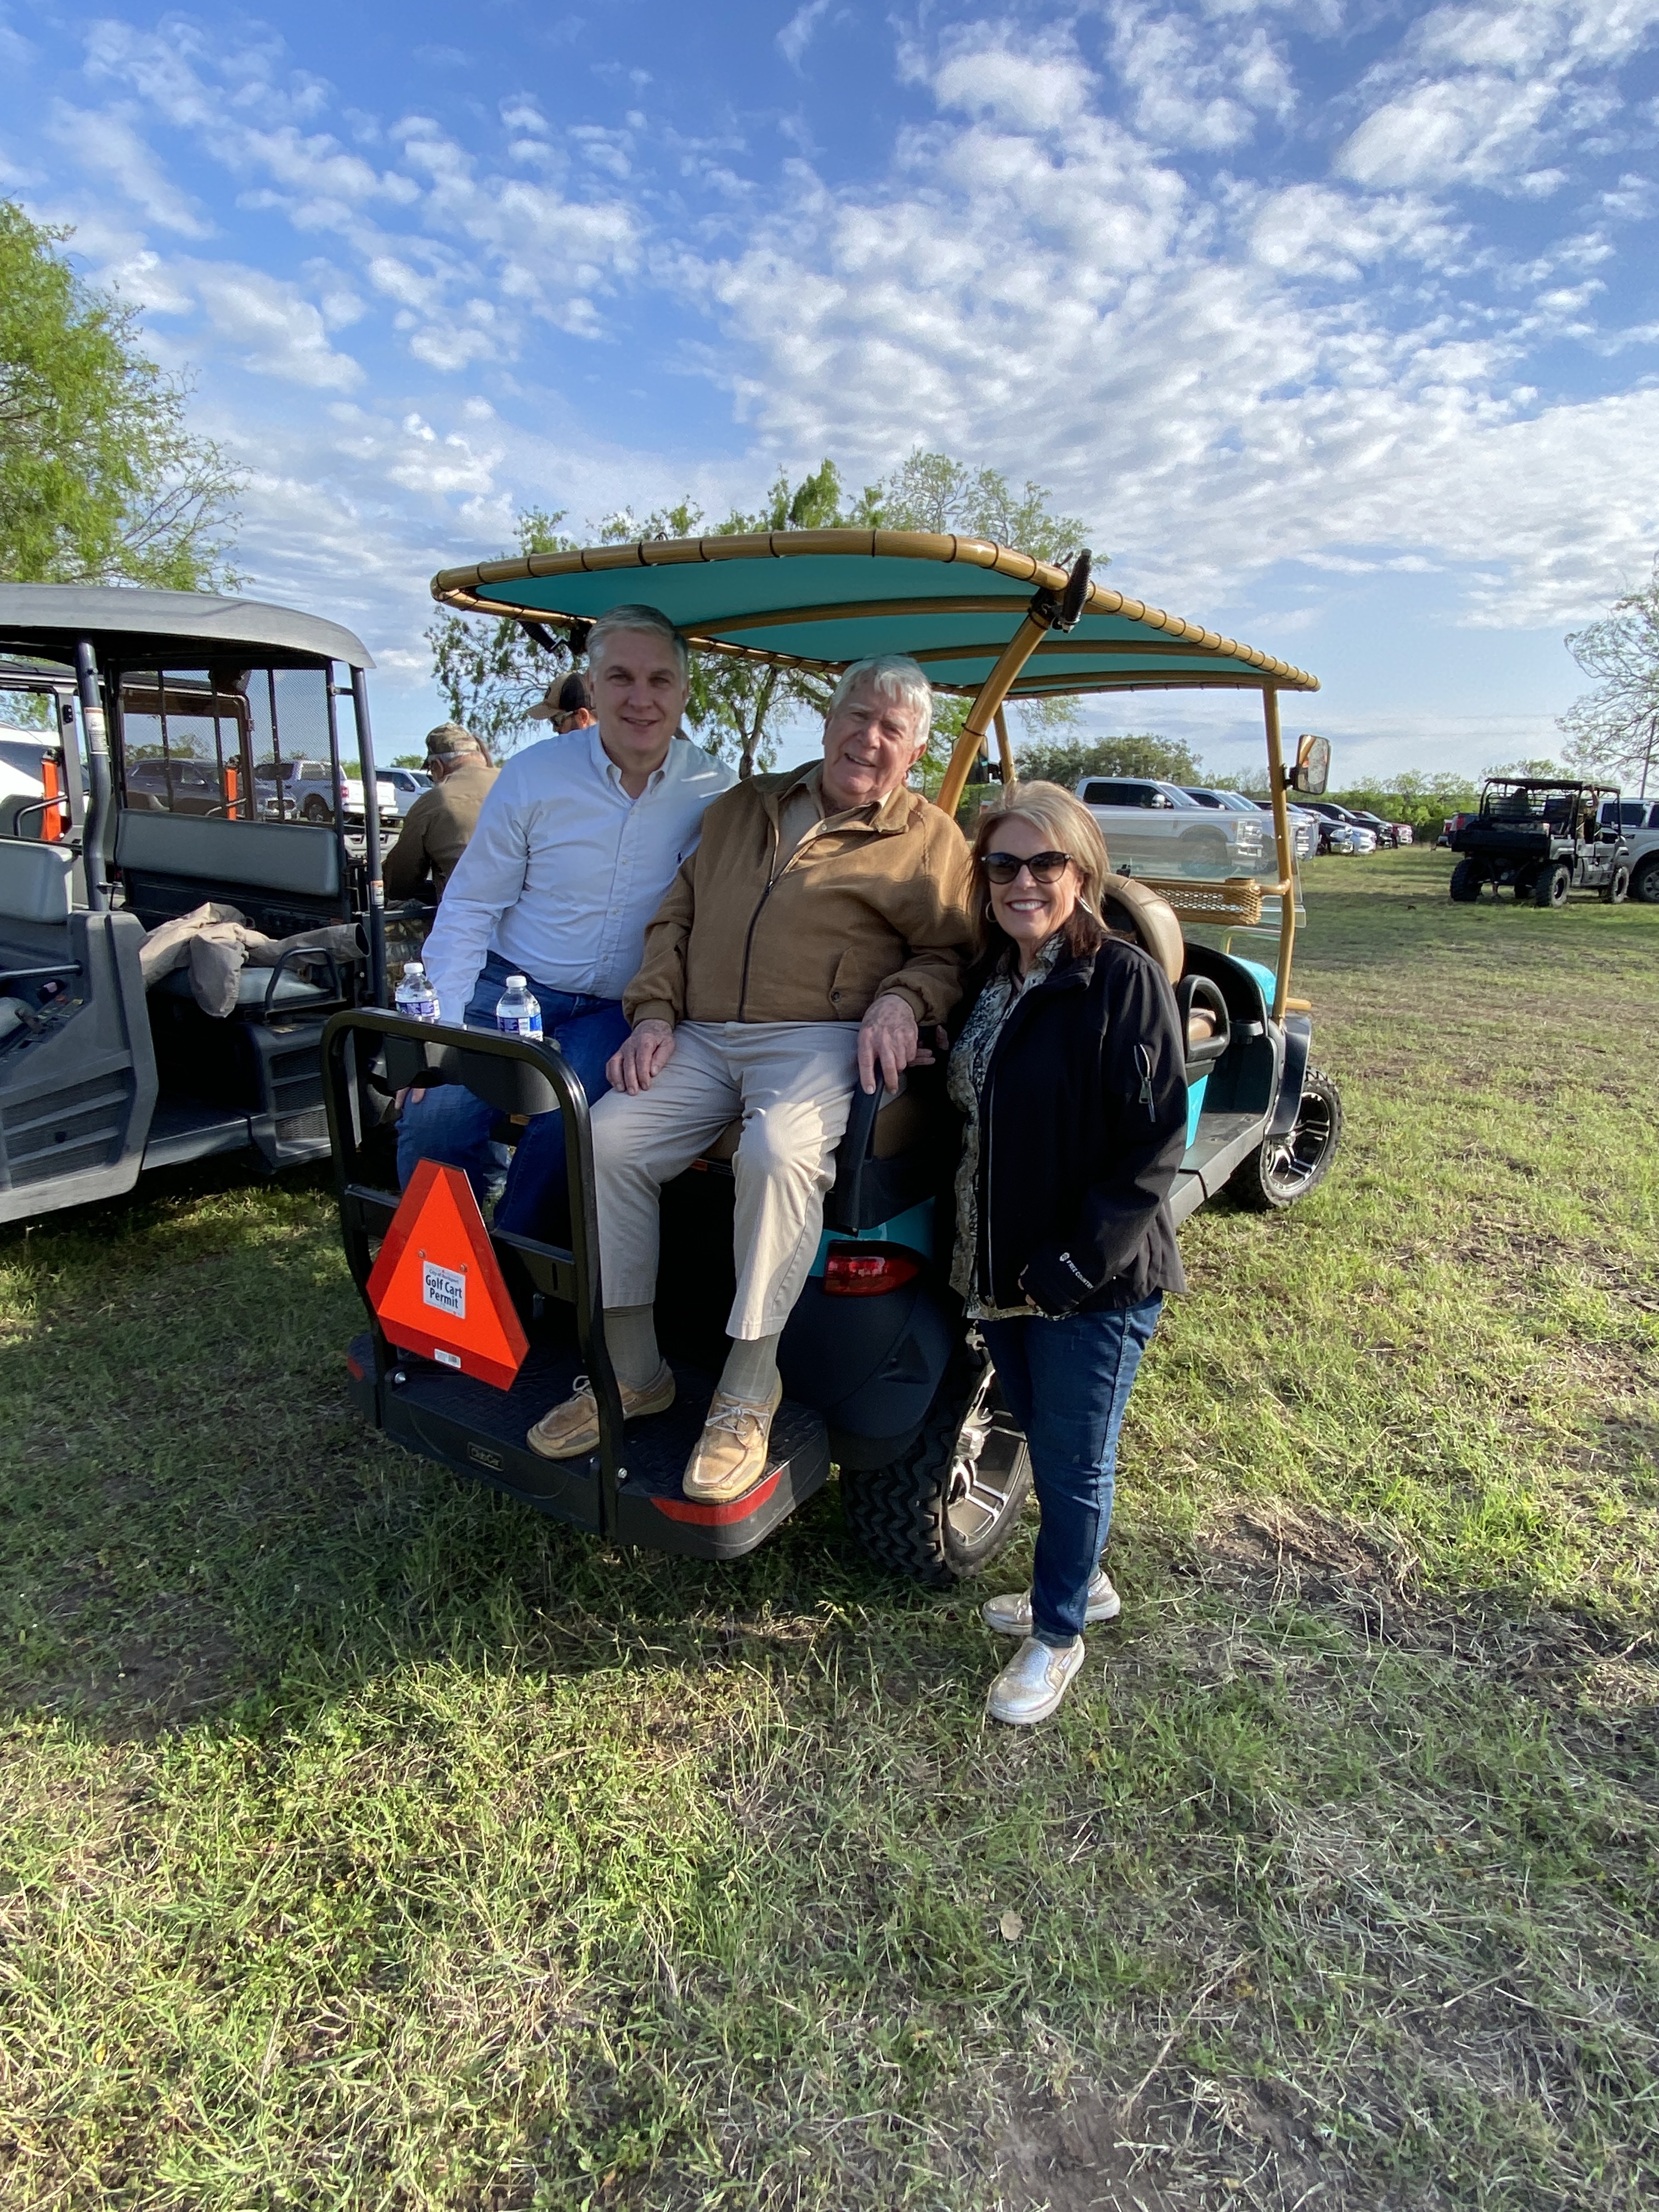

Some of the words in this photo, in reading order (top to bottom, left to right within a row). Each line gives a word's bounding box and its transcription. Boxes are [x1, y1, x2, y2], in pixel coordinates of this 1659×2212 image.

[426, 1274, 443, 1290] Golf
[445, 1282, 462, 1299] Cart
[1066, 1260, 1078, 1272] FREE
[1075, 1271, 1094, 1289] COUNTRY
[430, 1287, 458, 1308] Permit
